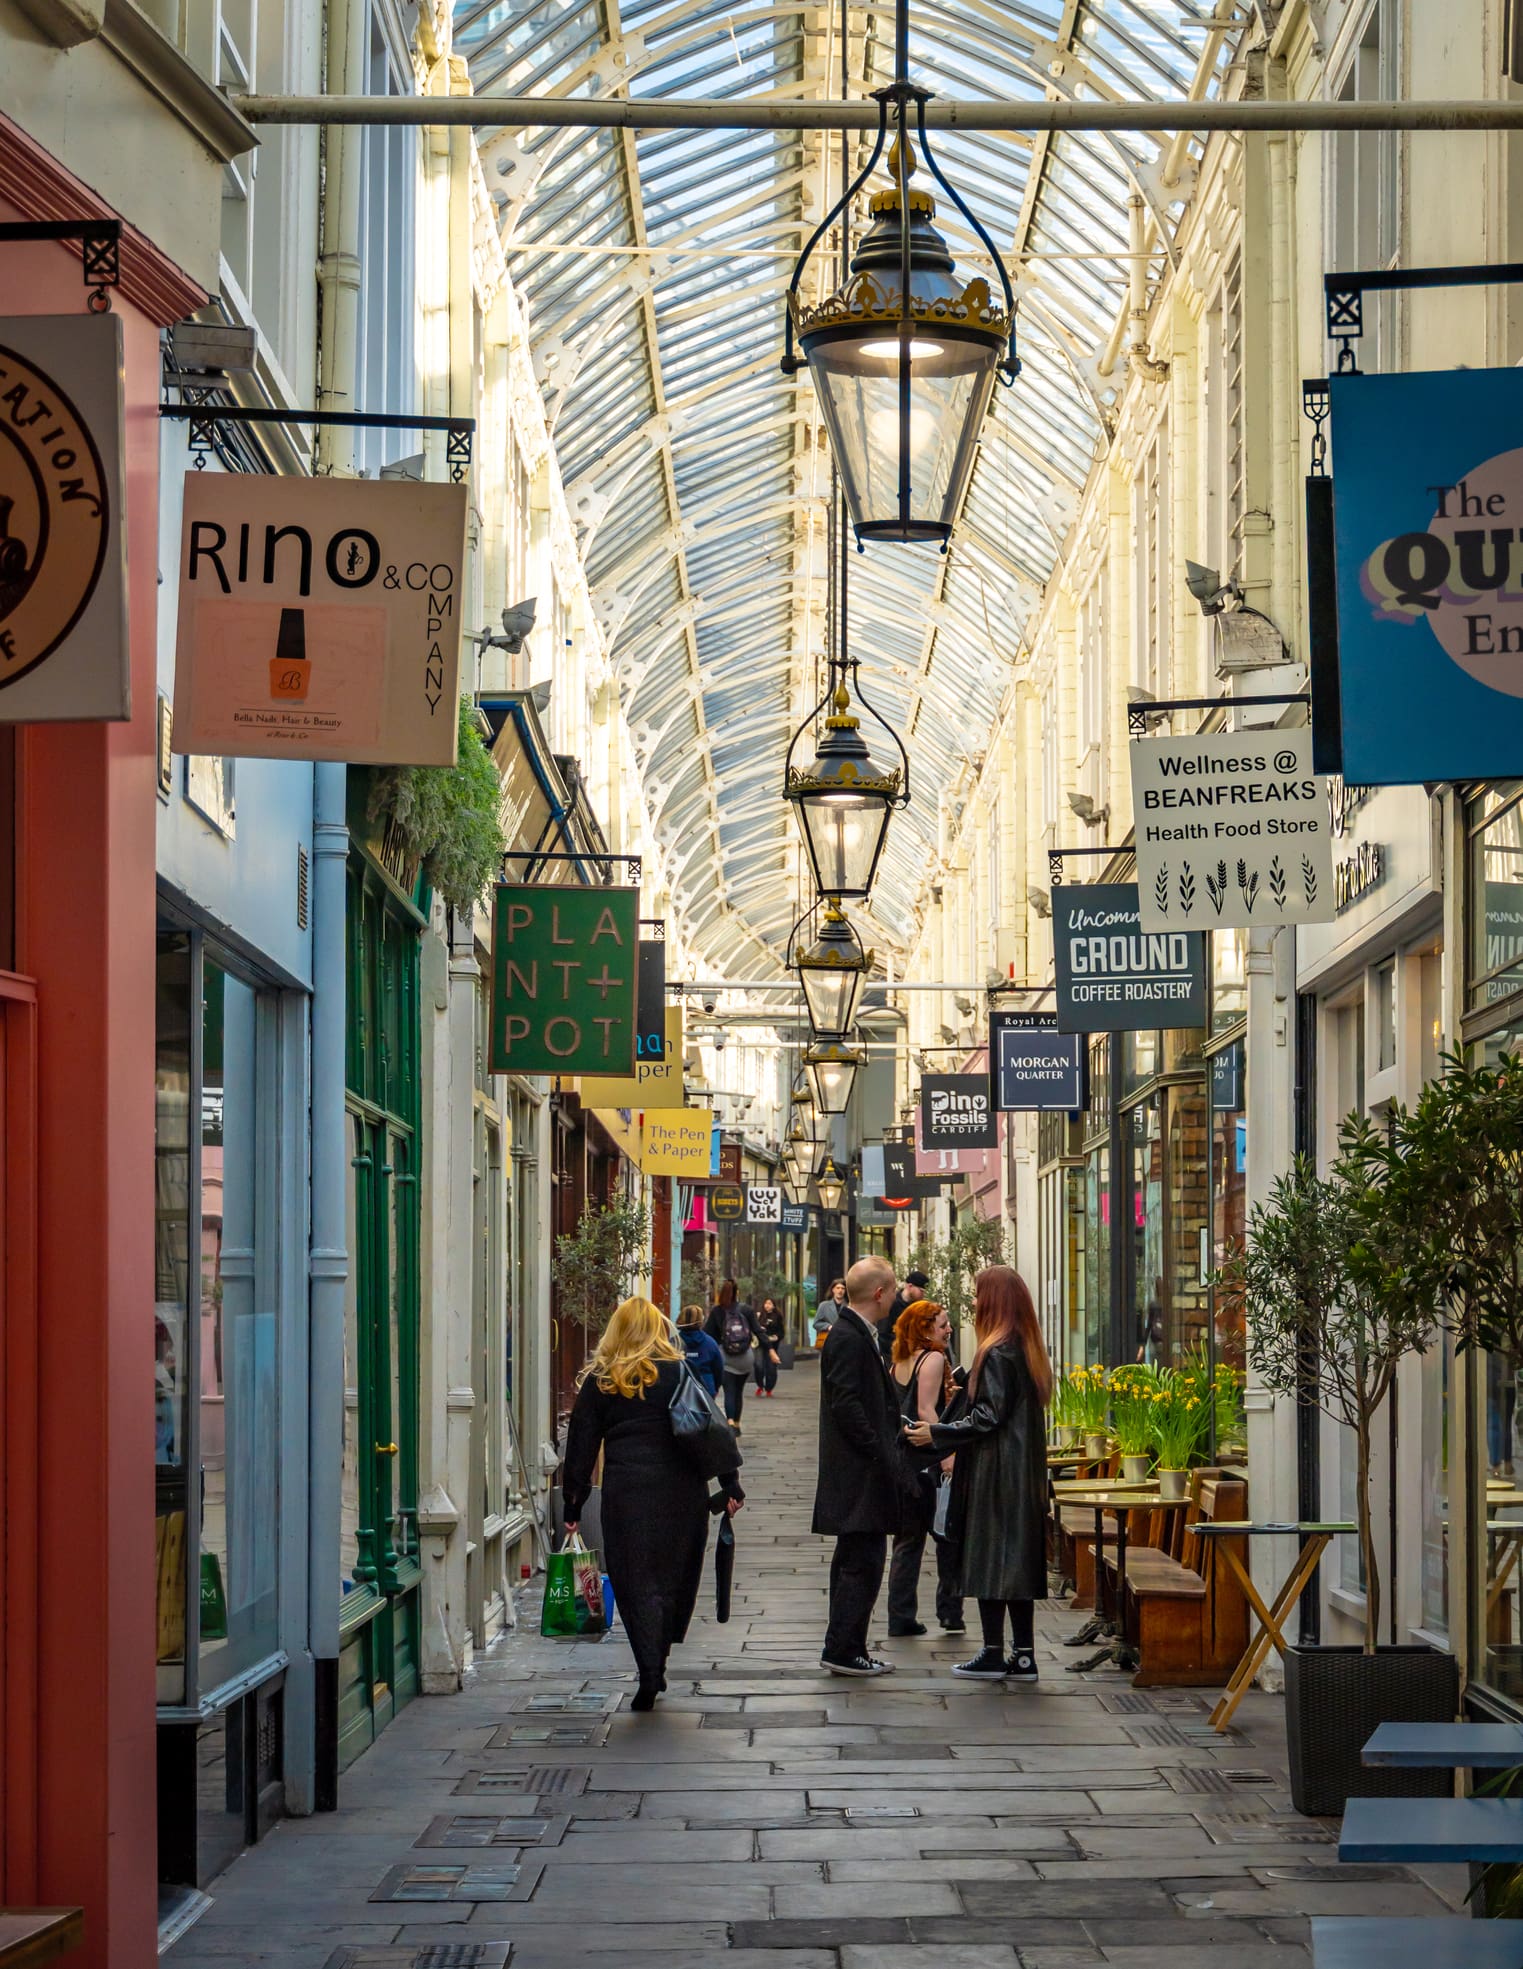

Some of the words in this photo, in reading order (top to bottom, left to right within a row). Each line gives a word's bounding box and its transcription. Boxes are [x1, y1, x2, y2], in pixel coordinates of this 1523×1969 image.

[1426, 482, 1506, 519] The
[1383, 528, 1523, 610] QU
[233, 712, 254, 722] Bella
[281, 715, 300, 724] Hair
[313, 716, 343, 728] Beauty
[1158, 754, 1267, 777] Wellness
[1273, 750, 1298, 775] @
[1144, 780, 1317, 810] BEANFREAKS
[1146, 823, 1209, 842] Health
[1214, 820, 1261, 838] Food
[1266, 818, 1319, 835] Store
[506, 903, 624, 946] PLA
[1070, 933, 1189, 974] GROUND
[1071, 983, 1122, 1003] COFFEE
[1125, 982, 1193, 1001] ROASTERY
[1004, 1017, 1035, 1027] Royal
[504, 1015, 622, 1057] POT
[1010, 1057, 1070, 1069] MORGAN
[1016, 1071, 1064, 1081] QUARTER
[931, 1090, 988, 1111] Dino
[931, 1111, 988, 1125] Fossils
[650, 1126, 677, 1140] The
[679, 1128, 705, 1141] Pen
[932, 1126, 989, 1134] CARDIFF
[648, 1145, 659, 1156] &
[663, 1143, 704, 1160] Paper
